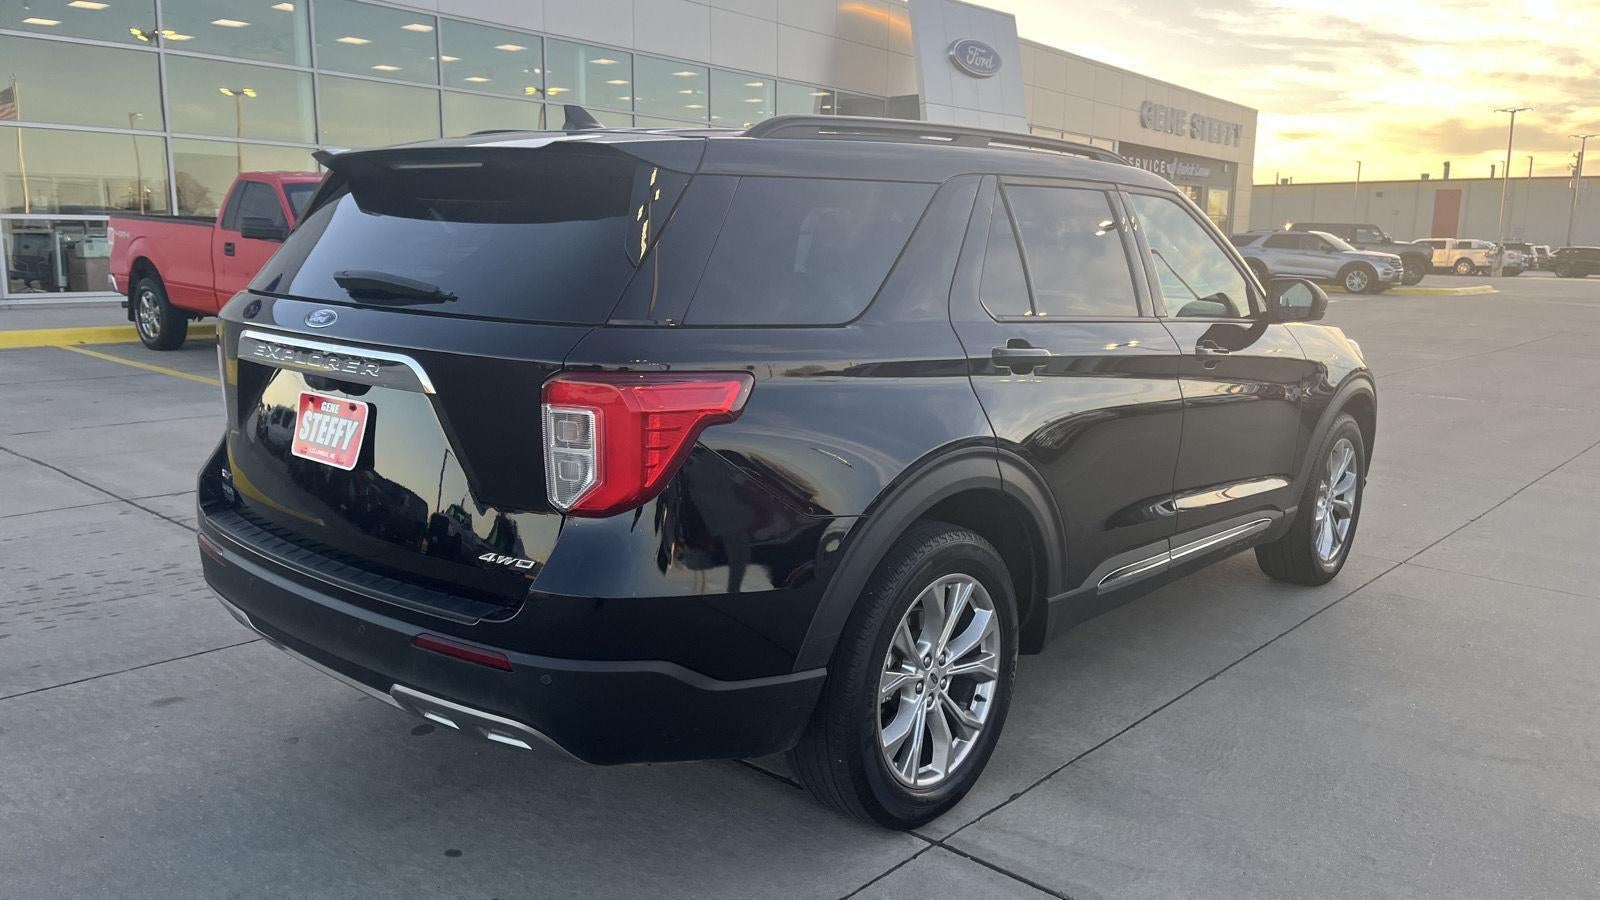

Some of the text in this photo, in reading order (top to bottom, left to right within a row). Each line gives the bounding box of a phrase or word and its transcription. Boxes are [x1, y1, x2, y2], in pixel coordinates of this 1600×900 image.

[966, 45, 994, 70] Ford
[1140, 100, 1243, 147] GENE STEFFY
[253, 344, 380, 377] EXPLORER
[321, 401, 341, 414] GENE
[299, 410, 359, 450] STEFFY
[478, 552, 536, 569] 4WD
